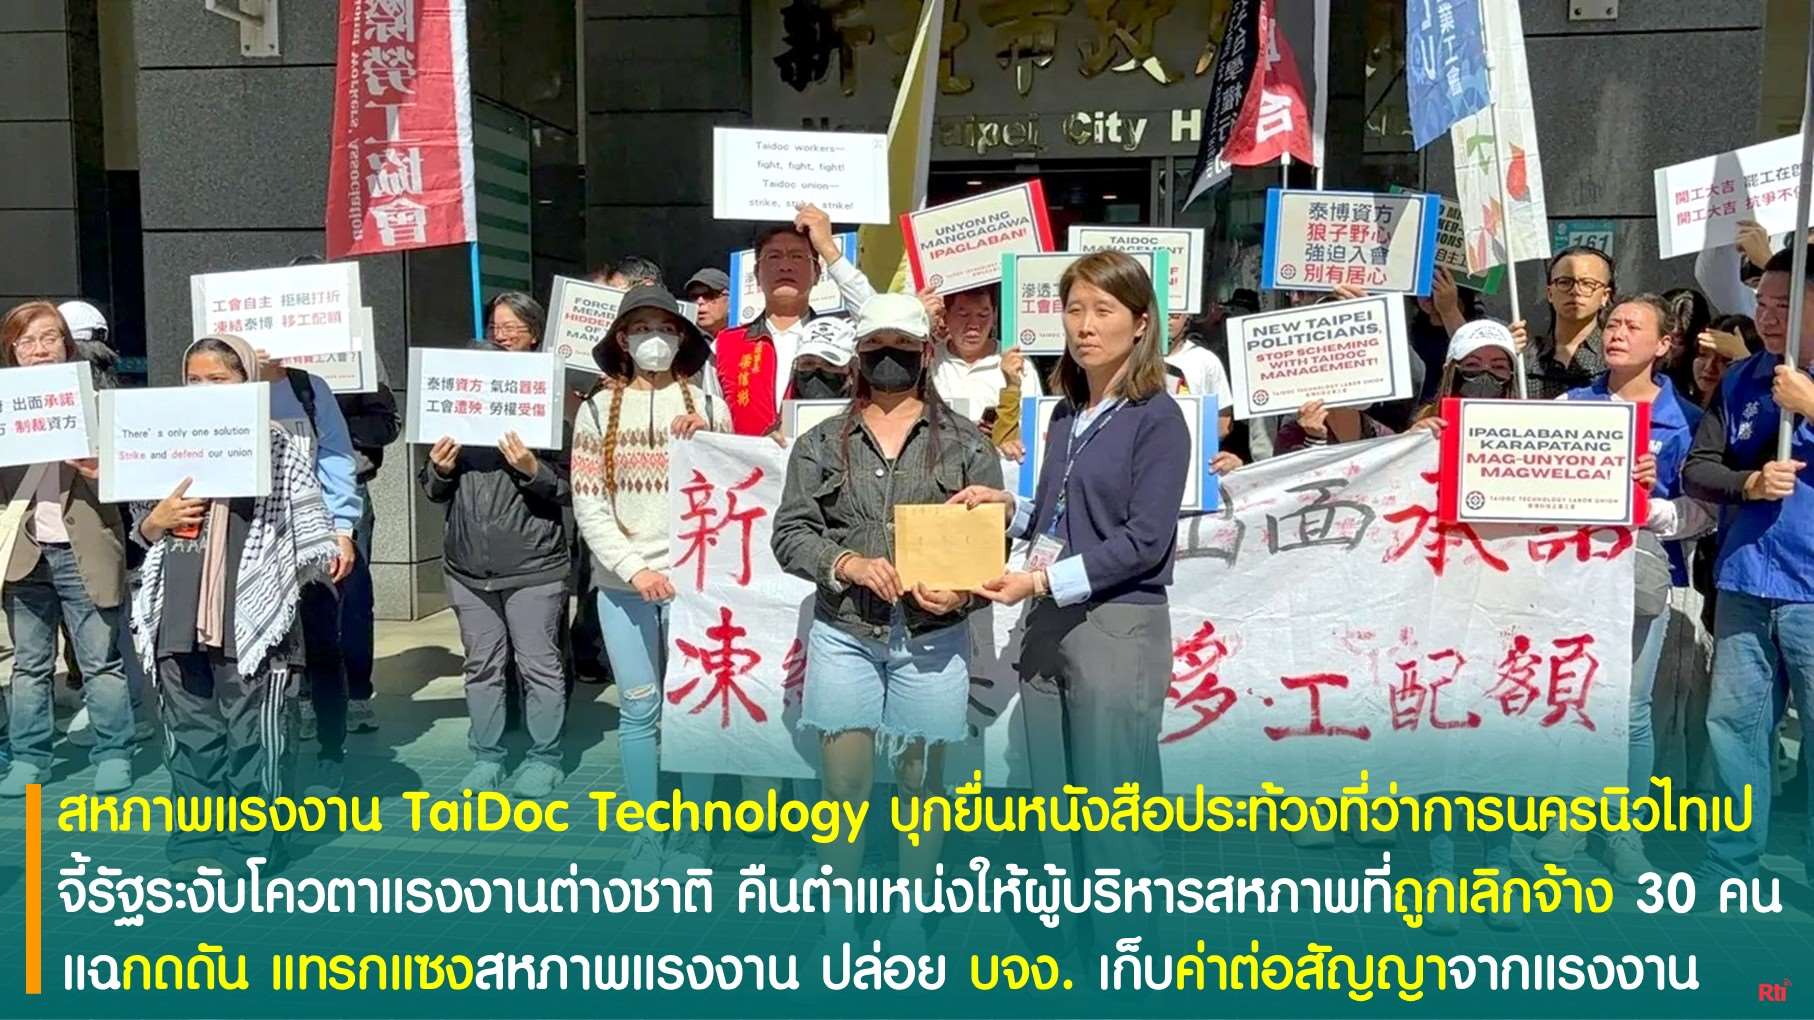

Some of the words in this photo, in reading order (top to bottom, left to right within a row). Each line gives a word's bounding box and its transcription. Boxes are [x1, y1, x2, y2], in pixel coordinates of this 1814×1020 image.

[939, 112, 1041, 155] aipei
[1063, 110, 1147, 151] City
[756, 141, 790, 151] Taidoc
[757, 160, 783, 170] fight,
[788, 161, 814, 171] fight,
[819, 162, 845, 172] fight!
[762, 179, 796, 189] Taidoc
[1675, 180, 1735, 205] 開工大吉
[1308, 202, 1394, 223] 泰博資方
[1677, 201, 1736, 226] 開工大吉
[920, 216, 1030, 250] MANGGAGAWA
[935, 214, 986, 236] UNYON
[988, 210, 1010, 224] NG
[1110, 236, 1158, 245] TAIDOC
[1307, 222, 1391, 245] 狼子野心
[930, 228, 1027, 260] IPAGLABAN!
[1305, 243, 1389, 266] 強迫入會
[1304, 263, 1387, 285] 別有居心
[213, 296, 272, 313] 工會自主
[281, 290, 340, 307] 拒絕打折
[575, 297, 617, 311] FORCE
[213, 316, 273, 333] 凍結泰博
[281, 311, 342, 328] 移工配額
[573, 305, 616, 319] MEMB
[1253, 321, 1301, 337] NEW
[1305, 310, 1372, 329] TAIPEI
[567, 330, 600, 342] MAN
[1247, 323, 1382, 351] POLITICIANS,
[1256, 350, 1294, 363] STOP
[1297, 338, 1379, 356] SCHEMING
[1270, 358, 1308, 370] WITH
[1311, 350, 1367, 364] TAIDOC
[1260, 358, 1378, 381] MANAGEMENT!
[427, 377, 482, 392] 泰博資方
[490, 379, 546, 395] 氣焰囂張
[426, 400, 482, 414] 工會遭殃
[490, 400, 546, 417] 勞權受傷
[15, 415, 77, 433] 制裁資方
[167, 427, 187, 439] only
[213, 426, 250, 437] solution
[1469, 427, 1578, 440] IPAGLABAN
[1582, 429, 1624, 440] ANG
[119, 451, 146, 461] Strike
[150, 450, 167, 460] and
[171, 449, 204, 459] defend
[208, 450, 224, 458] our
[227, 448, 253, 458] union
[1480, 440, 1611, 452] KARAPATANG
[1466, 453, 1596, 467] MAG-UNYON
[1600, 456, 1626, 467] AT
[1480, 467, 1611, 480] MAGWELGA!
